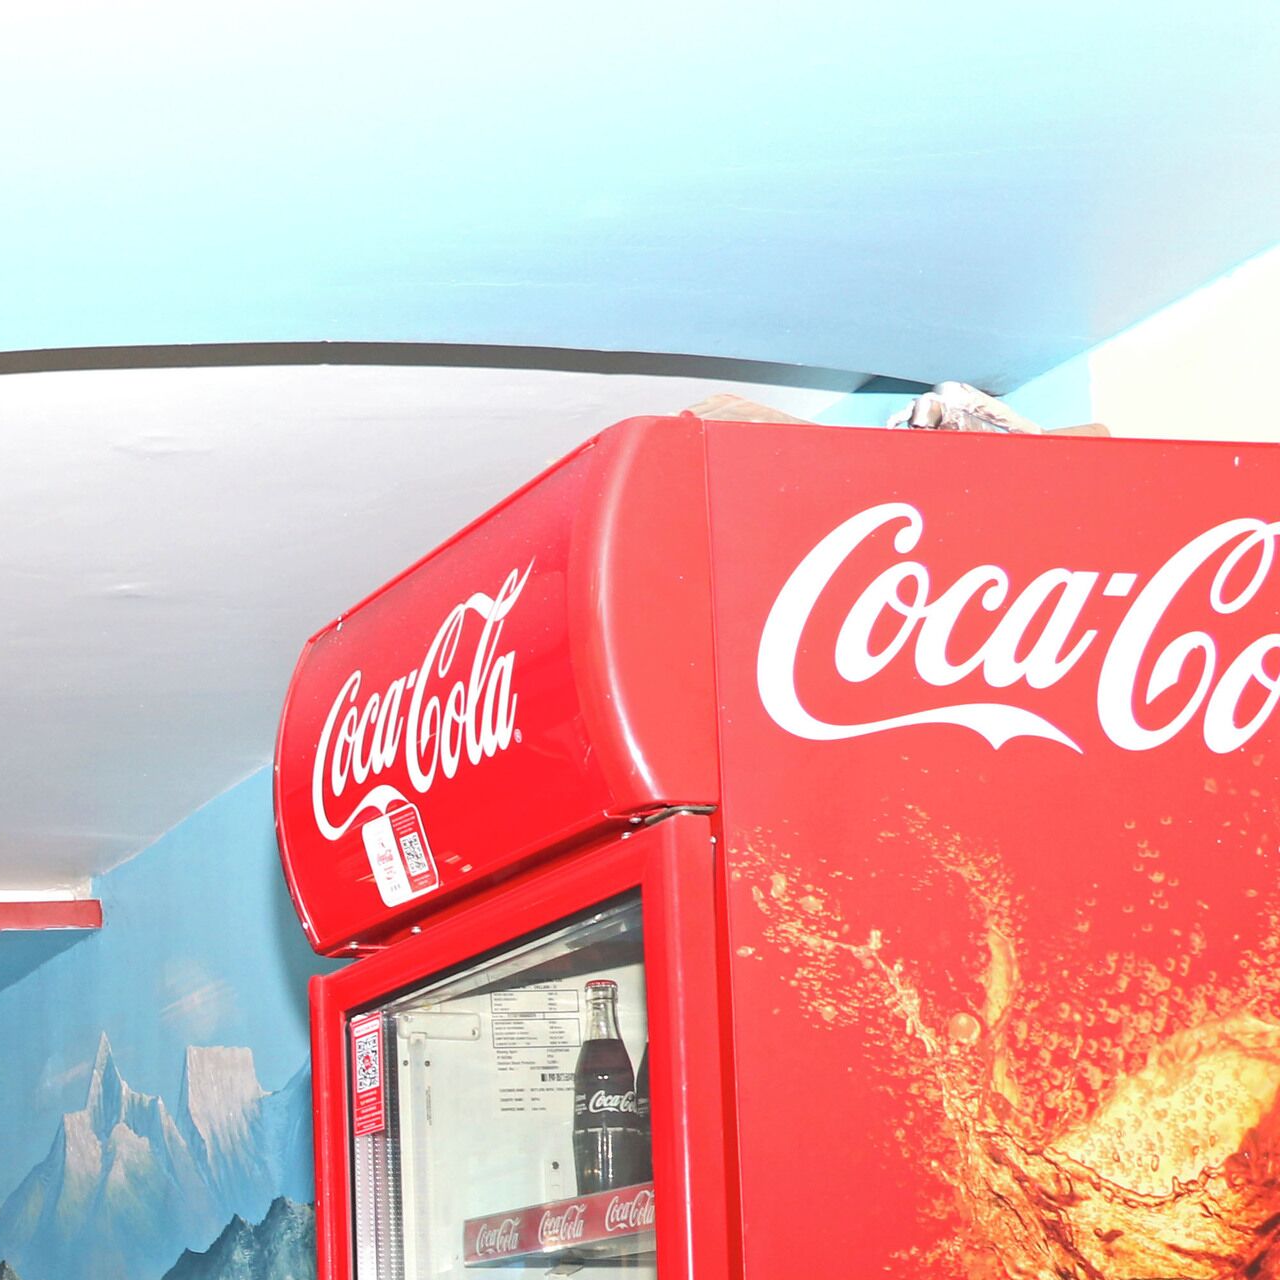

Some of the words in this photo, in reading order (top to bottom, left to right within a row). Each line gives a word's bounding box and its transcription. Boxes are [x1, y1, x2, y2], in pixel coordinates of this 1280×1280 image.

[312, 555, 536, 841] Coca-Cola
[476, 1217, 521, 1256] Coca-Cola
[538, 1203, 587, 1244] Coca-Cola
